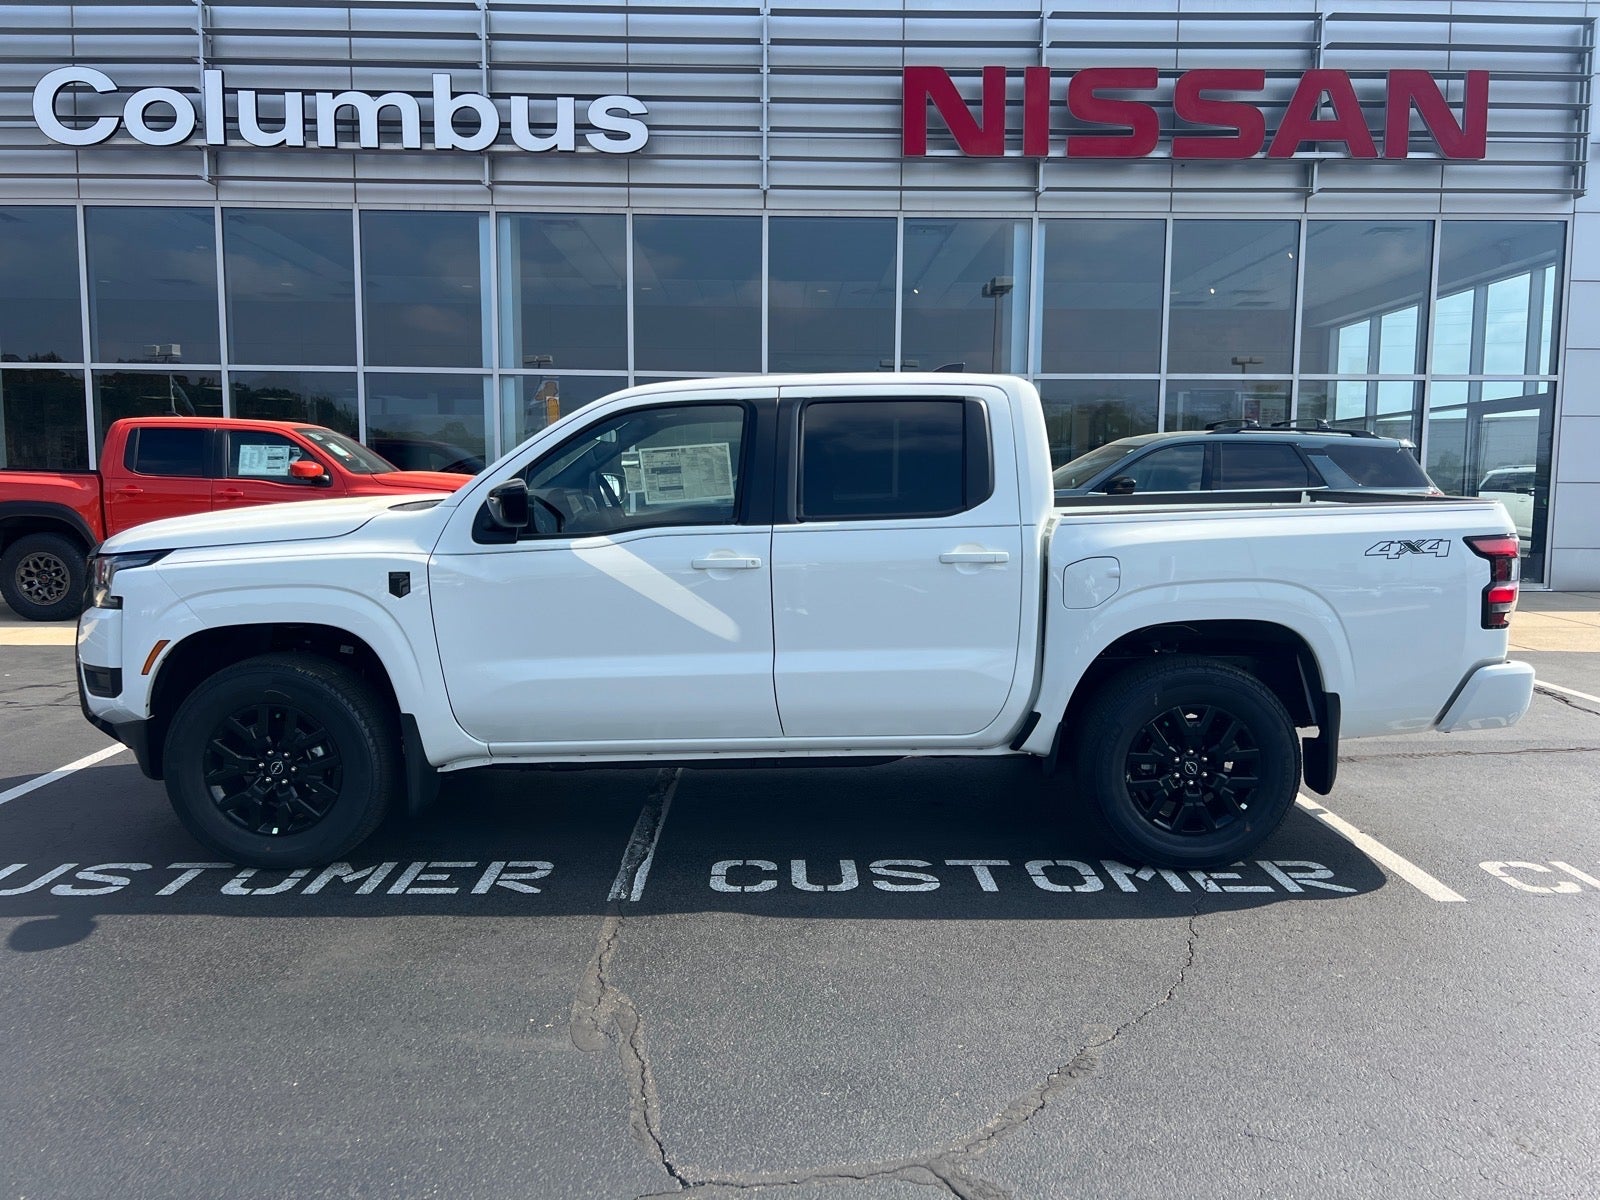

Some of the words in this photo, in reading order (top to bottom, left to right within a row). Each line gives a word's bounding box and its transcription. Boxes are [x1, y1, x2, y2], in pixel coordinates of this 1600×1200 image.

[32, 66, 649, 153] Columbus
[903, 66, 1489, 160] NISSAN
[709, 859, 1356, 894] CUSTOMER
